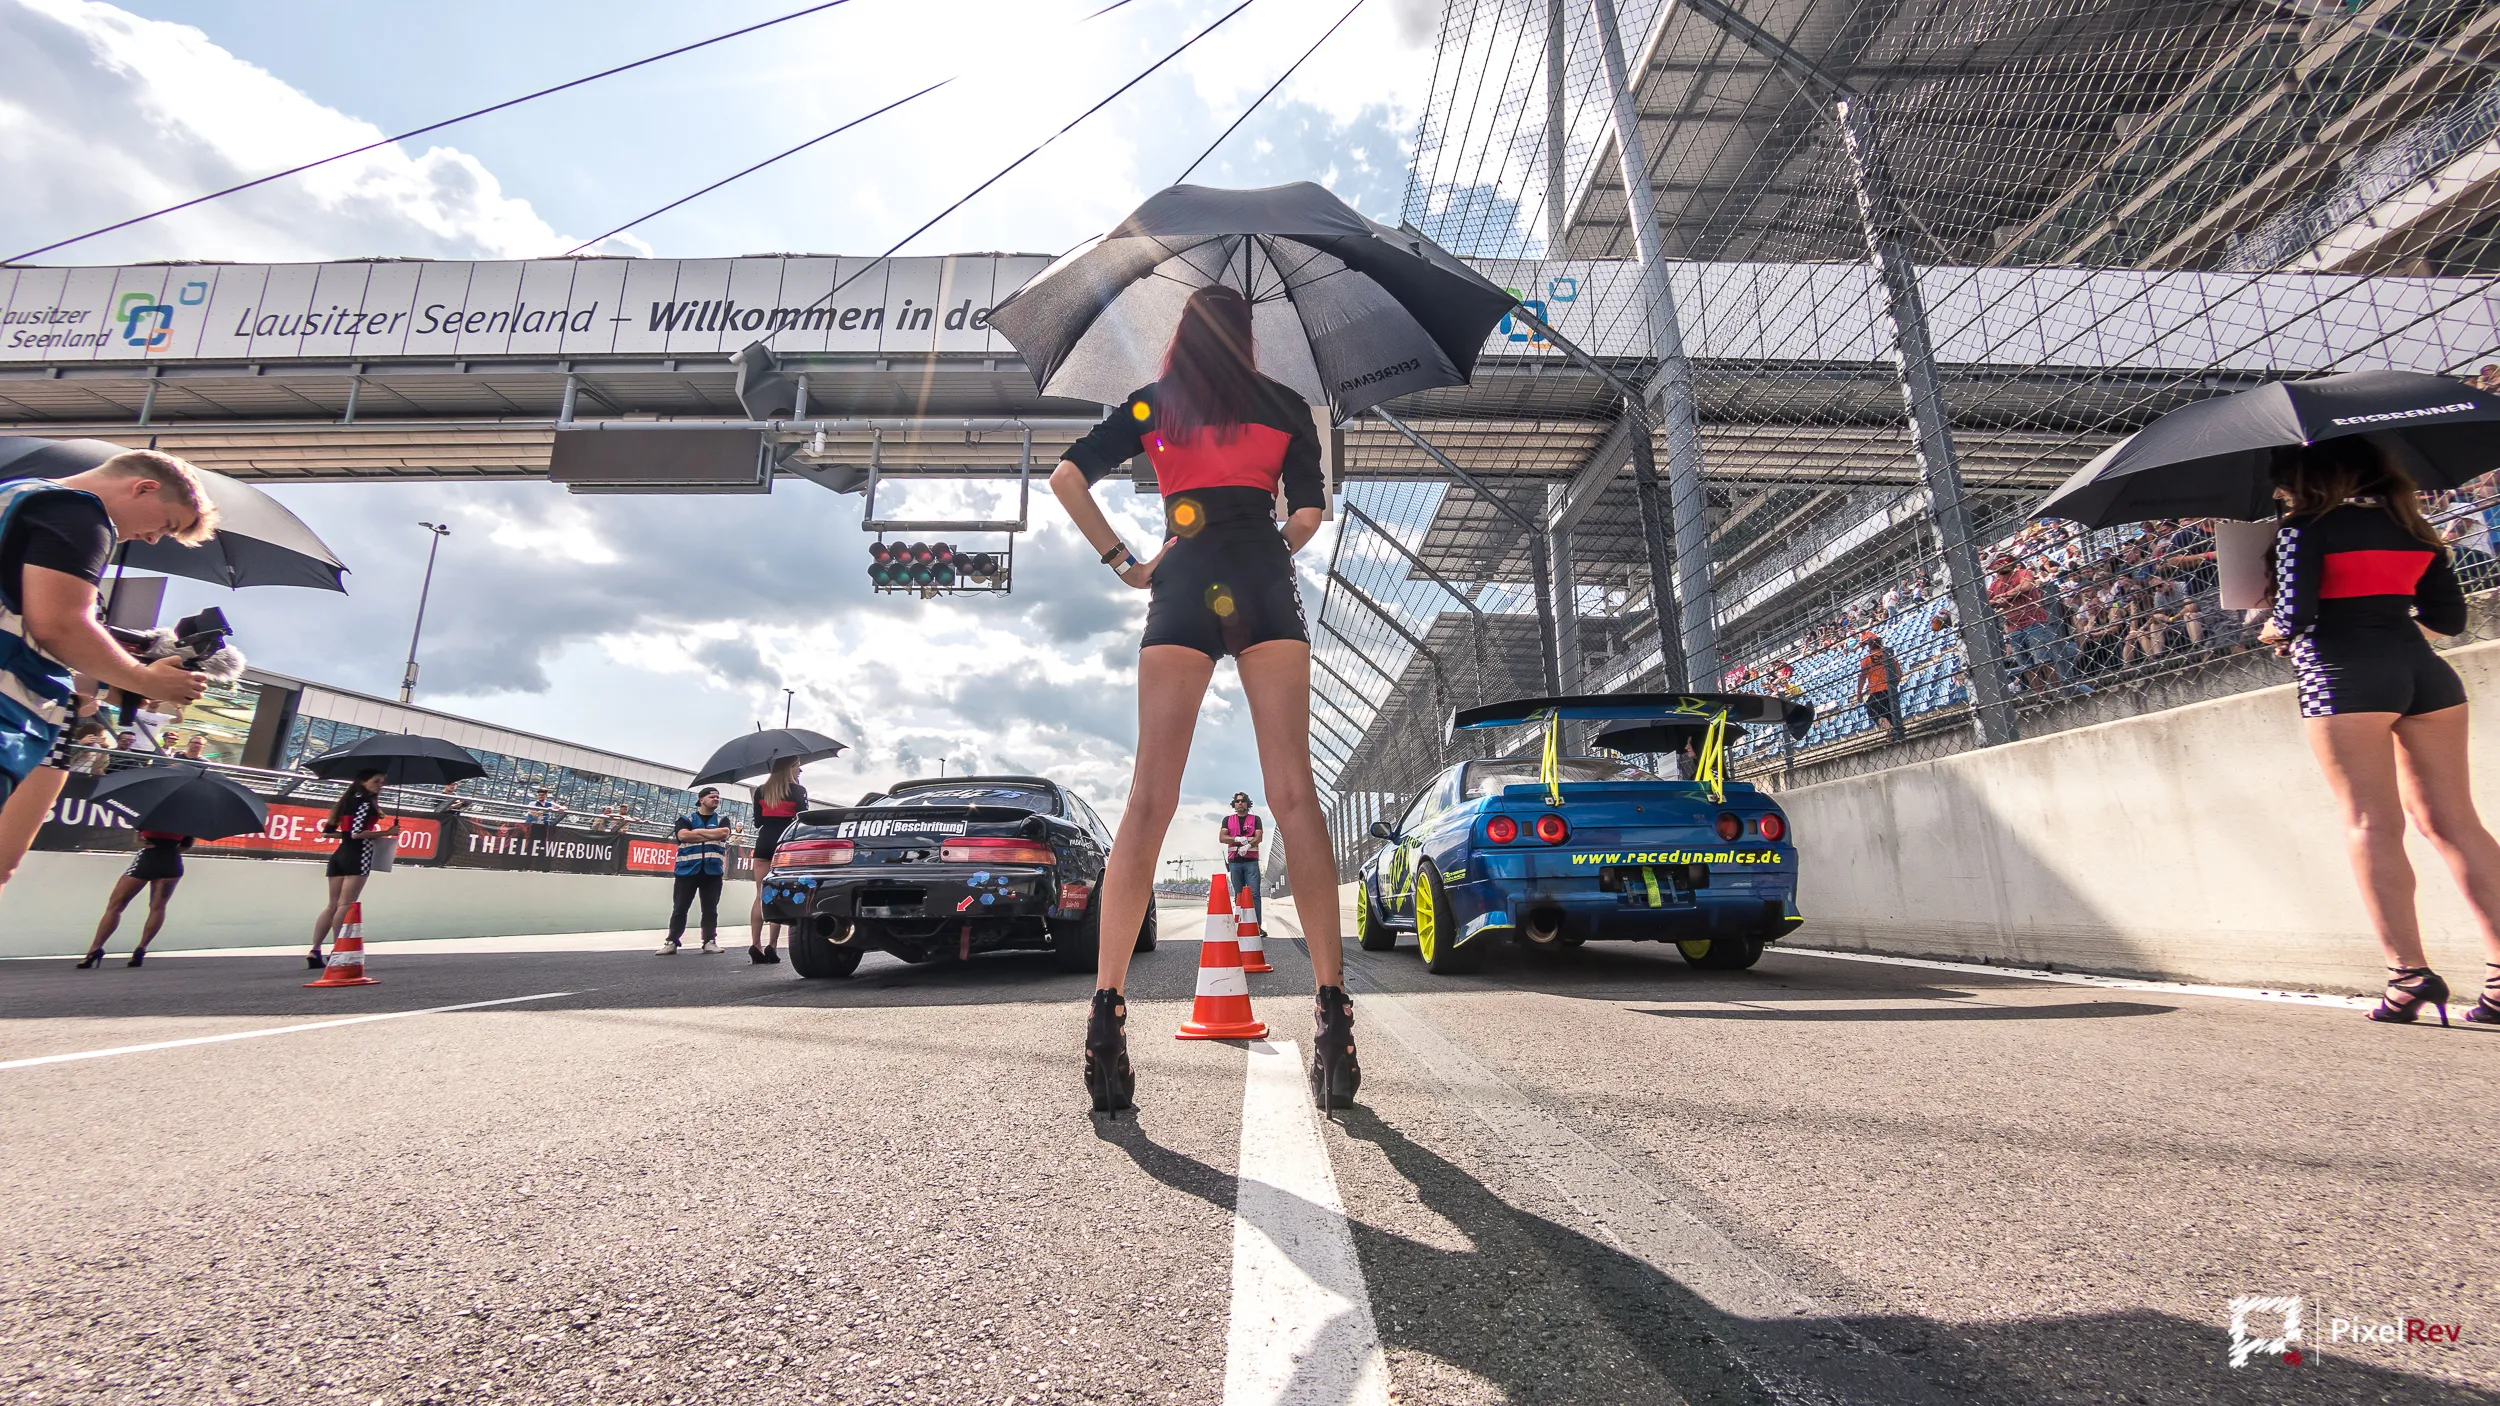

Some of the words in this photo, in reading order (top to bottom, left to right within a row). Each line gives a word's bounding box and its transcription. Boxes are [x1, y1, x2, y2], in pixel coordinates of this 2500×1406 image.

[0, 306, 92, 325] ausitzer
[233, 305, 408, 337] Lausitzer
[415, 301, 599, 334] Seenland
[648, 299, 885, 332] Willkommen
[896, 299, 932, 331] in
[944, 298, 997, 331] de
[7, 328, 114, 348] Seenland
[2331, 401, 2477, 426] REISBRENNEN
[857, 819, 893, 837] HOF
[468, 834, 613, 861] THIELE-WERBUNG
[632, 847, 679, 866] WERBE-
[1571, 850, 1782, 865] www.racedynamics.de
